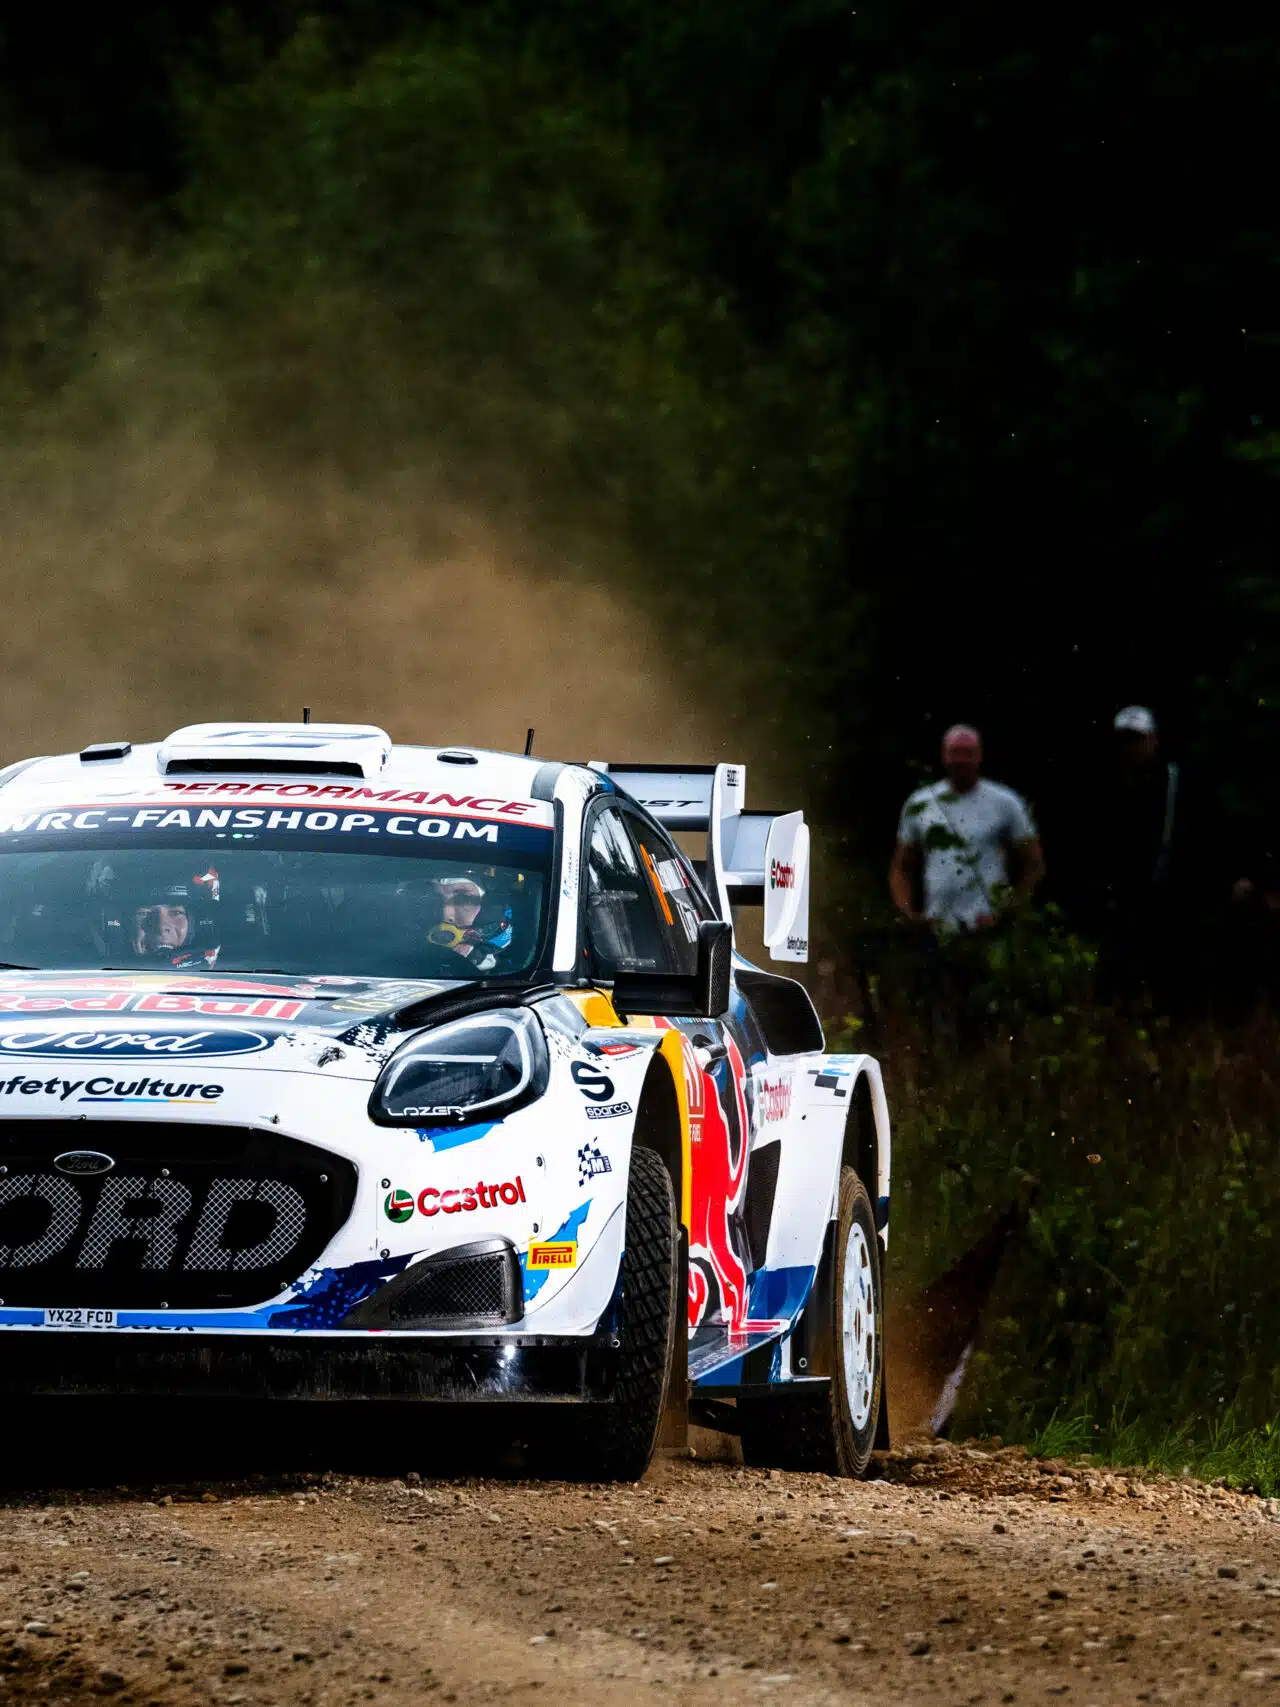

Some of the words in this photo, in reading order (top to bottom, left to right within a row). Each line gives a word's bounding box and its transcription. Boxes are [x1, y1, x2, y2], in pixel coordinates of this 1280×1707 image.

[144, 783, 537, 815] PERFORMANCE
[134, 995, 308, 1020] Bull
[1, 1030, 203, 1053] Ford
[586, 1102, 630, 1119] sparco
[418, 1176, 526, 1216] Castrol
[532, 1247, 572, 1265] PIRELLI
[48, 1309, 82, 1323] YX22
[86, 1311, 113, 1323] FCD
